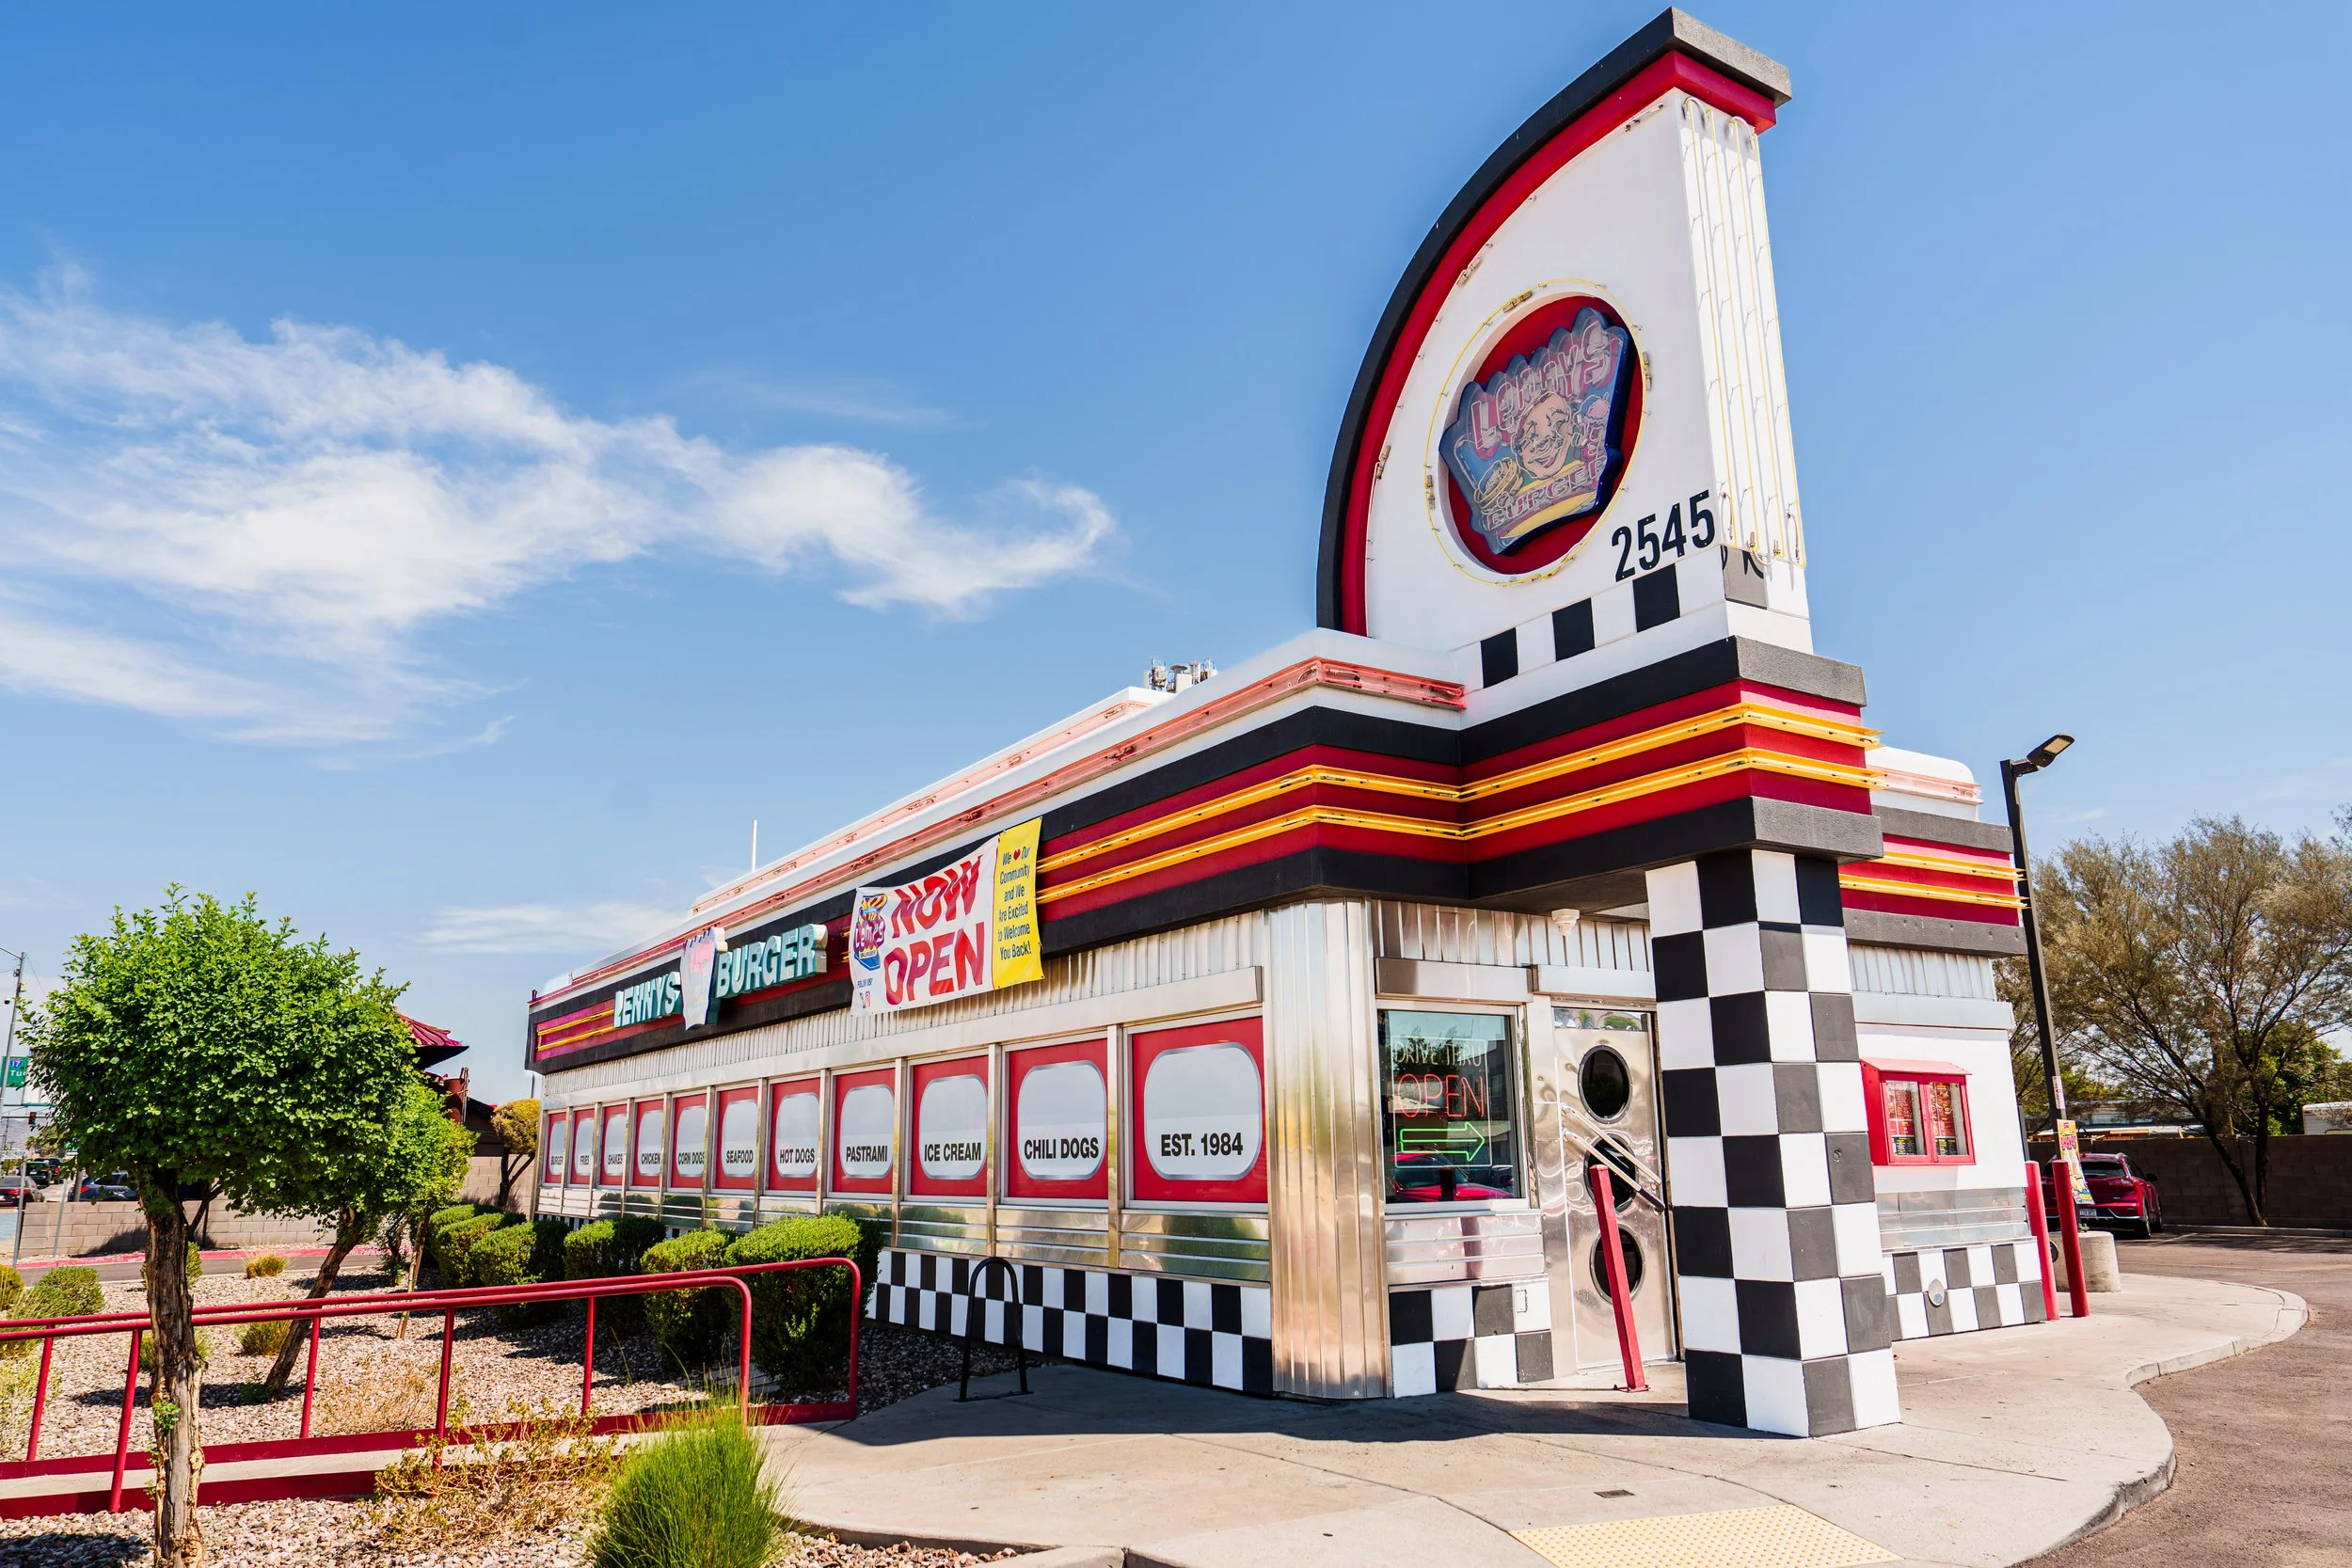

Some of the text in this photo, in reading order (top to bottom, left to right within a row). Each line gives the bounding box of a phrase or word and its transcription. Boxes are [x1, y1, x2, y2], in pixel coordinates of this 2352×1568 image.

[1612, 489, 1715, 582] 2545
[1002, 847, 1031, 865] We Our
[999, 863, 1031, 884] Community
[891, 854, 984, 939] NOW
[1004, 884, 1025, 902] and We
[998, 901, 1029, 923] Are Excited
[997, 923, 1031, 942] to Welcome
[999, 940, 1032, 960] You Back!
[715, 924, 829, 998] BURGER
[883, 922, 985, 1006] OPEN
[1392, 1040, 1482, 1067] DRIVE THRU
[1397, 1073, 1485, 1118] OPEN
[846, 1145, 888, 1163] PASTRAMI
[924, 1142, 981, 1162] ICE CREAM
[1024, 1136, 1099, 1160] CHILI DOGS
[1160, 1132, 1244, 1157] EST. 1984
[641, 1152, 660, 1165] CHICKEN
[677, 1151, 705, 1165] CORN DOGS
[725, 1149, 754, 1164] SEAFOOD
[779, 1148, 815, 1164] HOT DOGS
